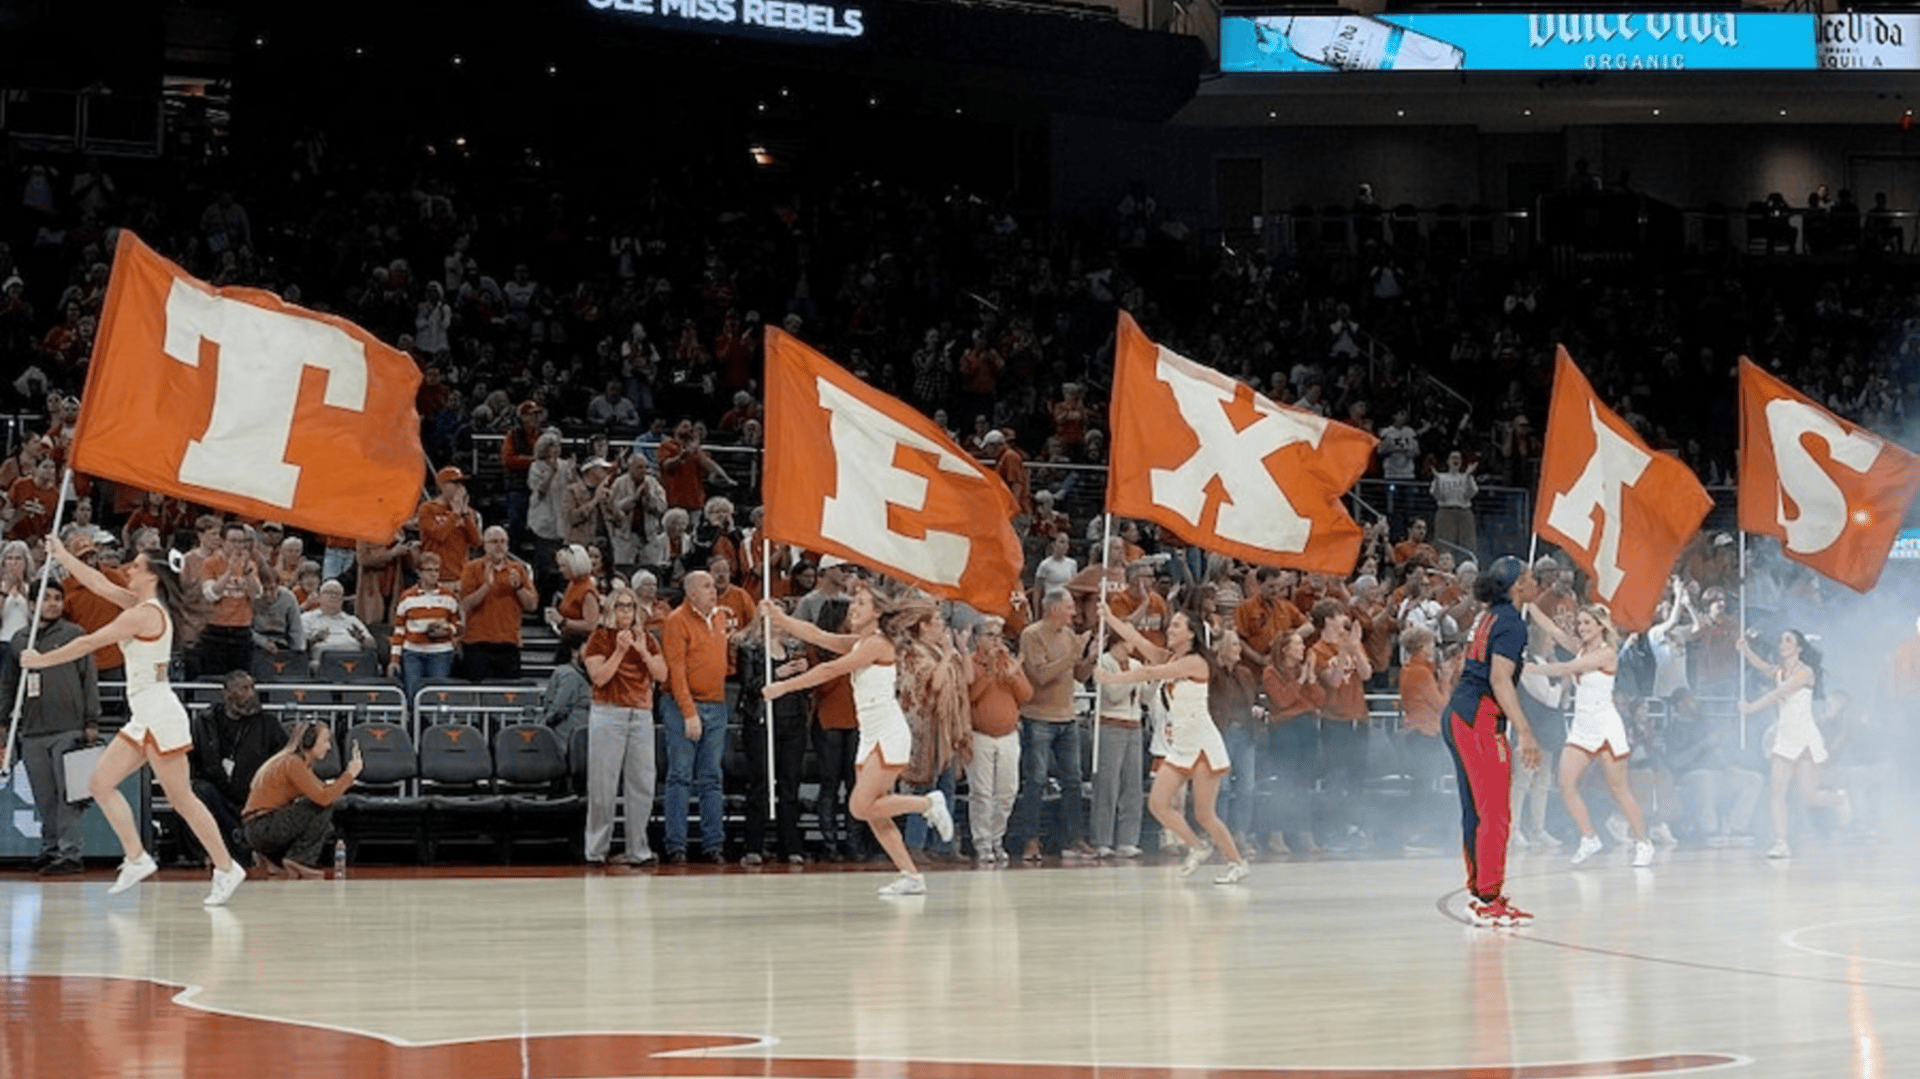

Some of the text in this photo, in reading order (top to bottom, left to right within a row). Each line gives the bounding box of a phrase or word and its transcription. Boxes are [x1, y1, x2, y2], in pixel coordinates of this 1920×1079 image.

[661, 0, 737, 23] MISS
[743, 0, 864, 37] REBELS
[1583, 53, 1685, 69] ORGANIC
[164, 277, 368, 509] T
[816, 376, 985, 588] E
[1150, 344, 1329, 553] X
[1765, 398, 1884, 554] S
[1547, 398, 1653, 602] A
